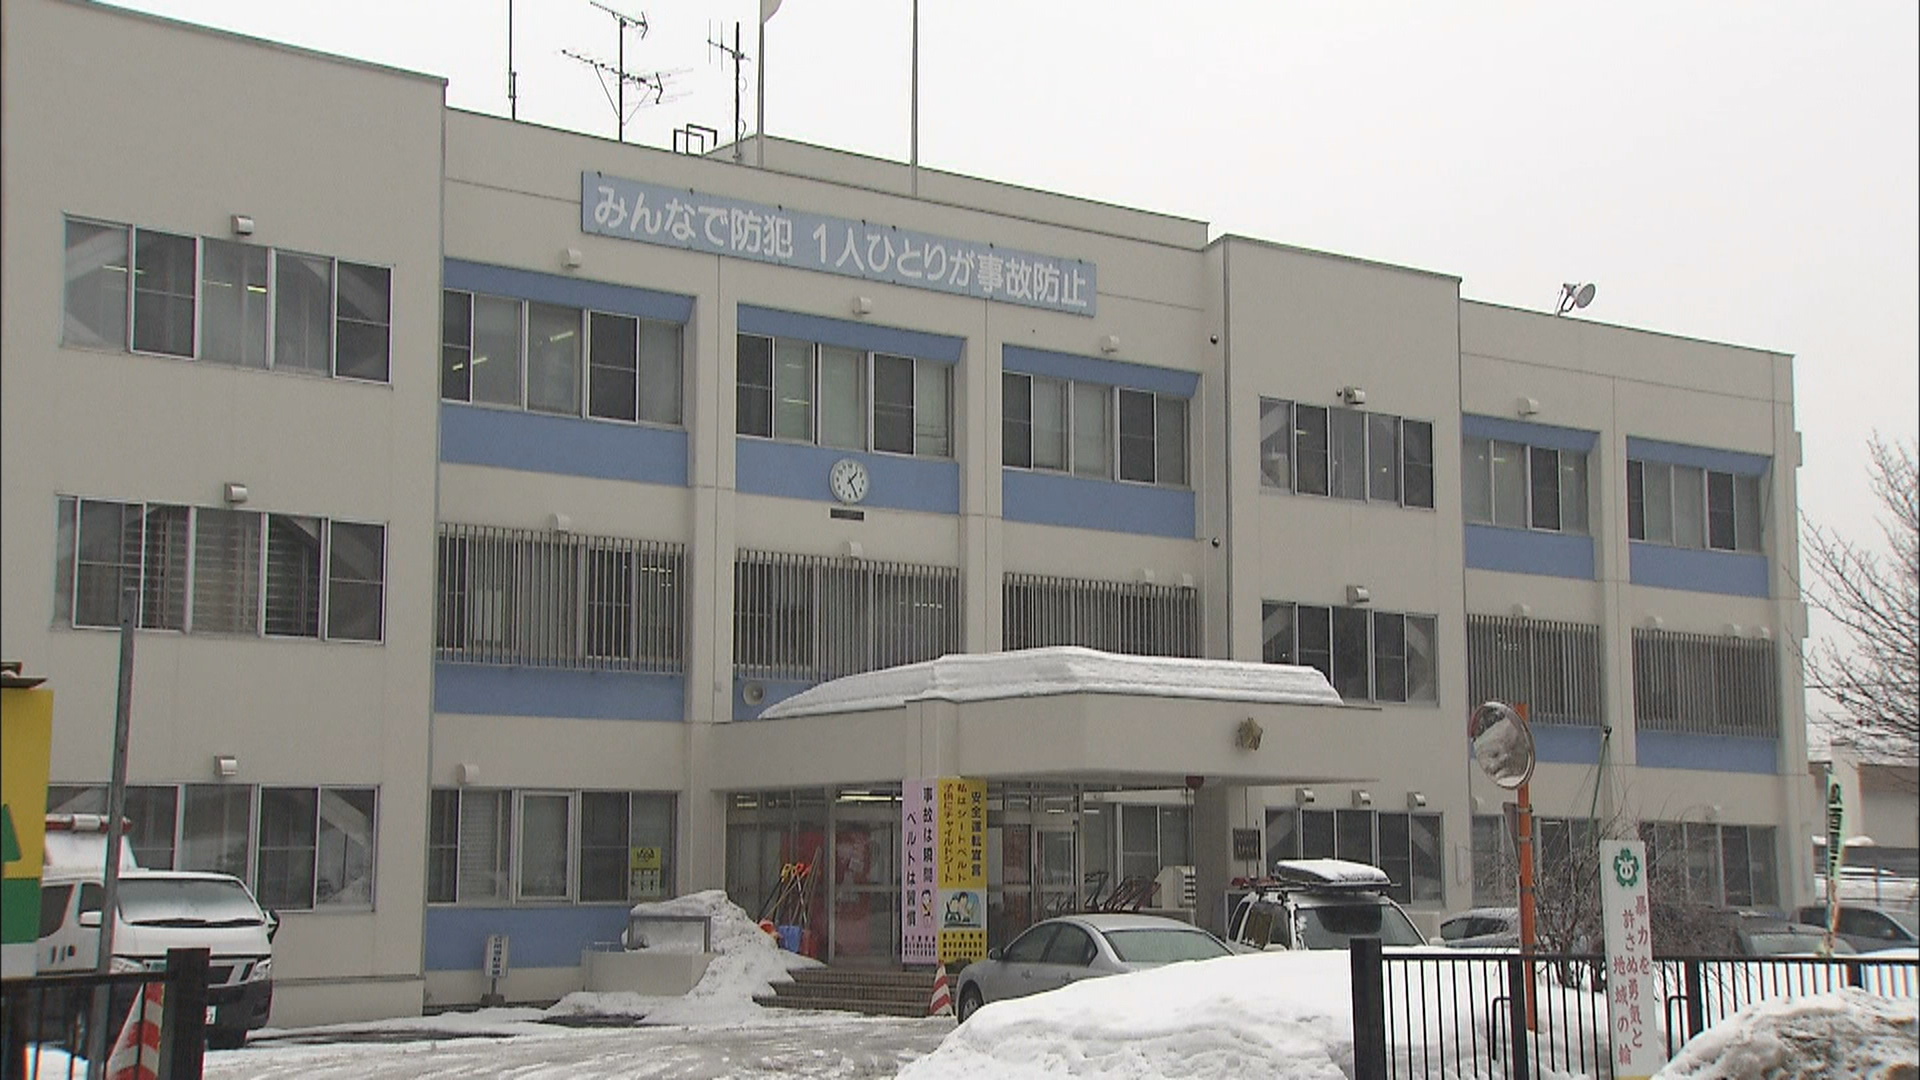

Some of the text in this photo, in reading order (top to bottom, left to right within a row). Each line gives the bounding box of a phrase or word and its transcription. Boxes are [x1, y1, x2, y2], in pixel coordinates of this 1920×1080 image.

[594, 185, 794, 258] みんなで防犯
[906, 811, 917, 928] ベルトは習慣
[923, 787, 933, 883] 事故は瞬間
[957, 783, 968, 883] 私はシートベルト
[1622, 909, 1643, 1048] 許さぬ勇気と
[1635, 895, 1650, 976] 暴力を
[1613, 956, 1632, 1066] 地域の輪
